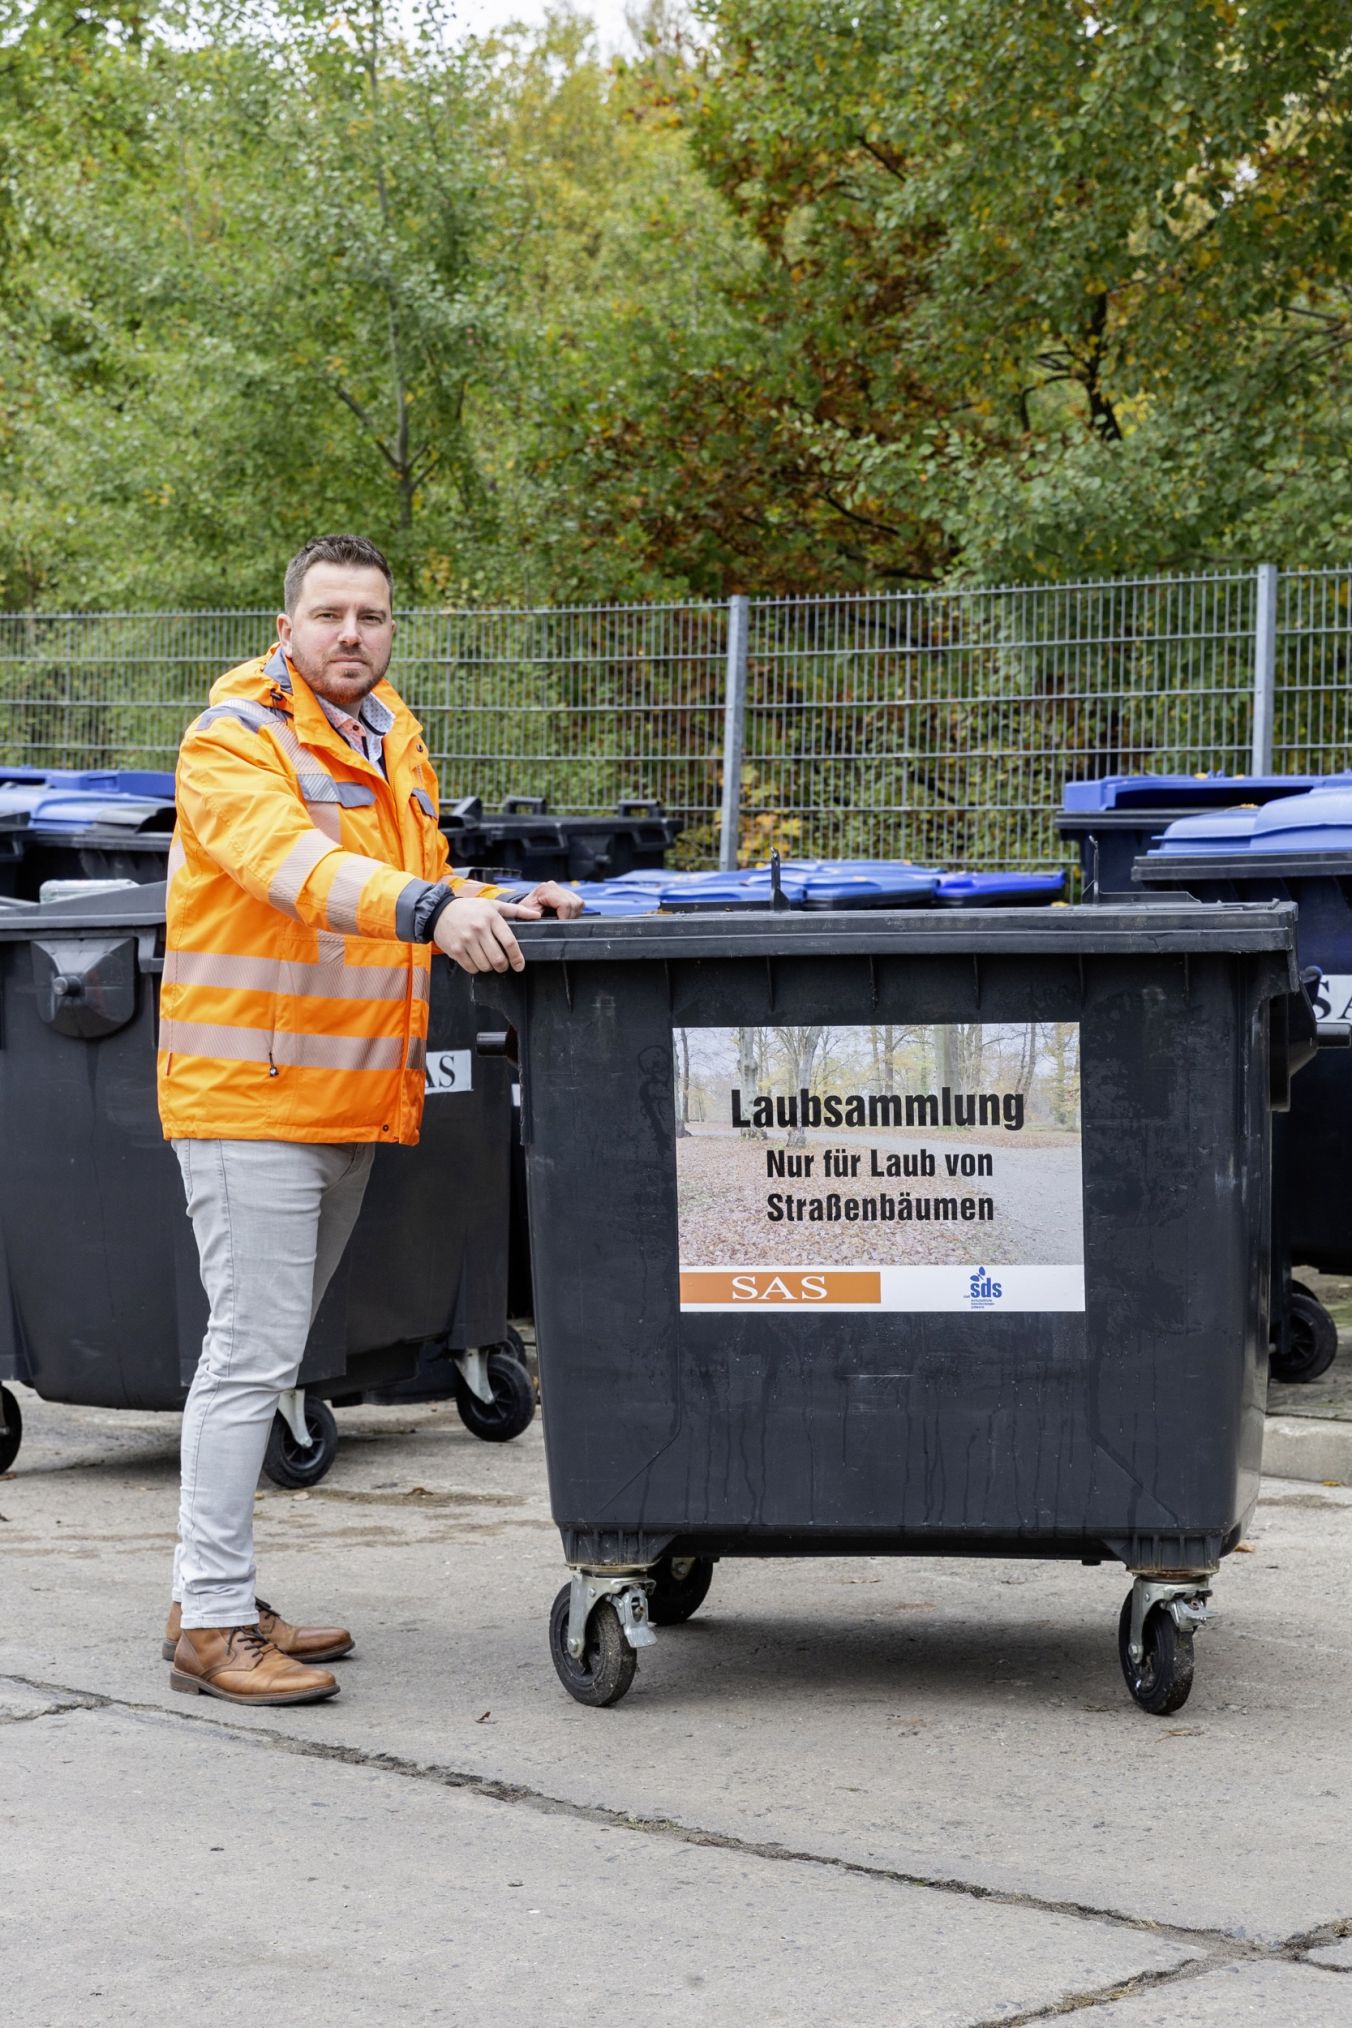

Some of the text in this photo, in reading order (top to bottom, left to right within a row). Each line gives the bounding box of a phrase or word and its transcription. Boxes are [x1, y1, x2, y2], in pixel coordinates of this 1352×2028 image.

[731, 1087, 1024, 1131] Laubsammlung
[766, 1148, 993, 1178] Nur für Laub von
[767, 1193, 994, 1222] Straßenbäumen
[731, 1275, 828, 1300] SAS
[970, 1277, 1002, 1298] sds
